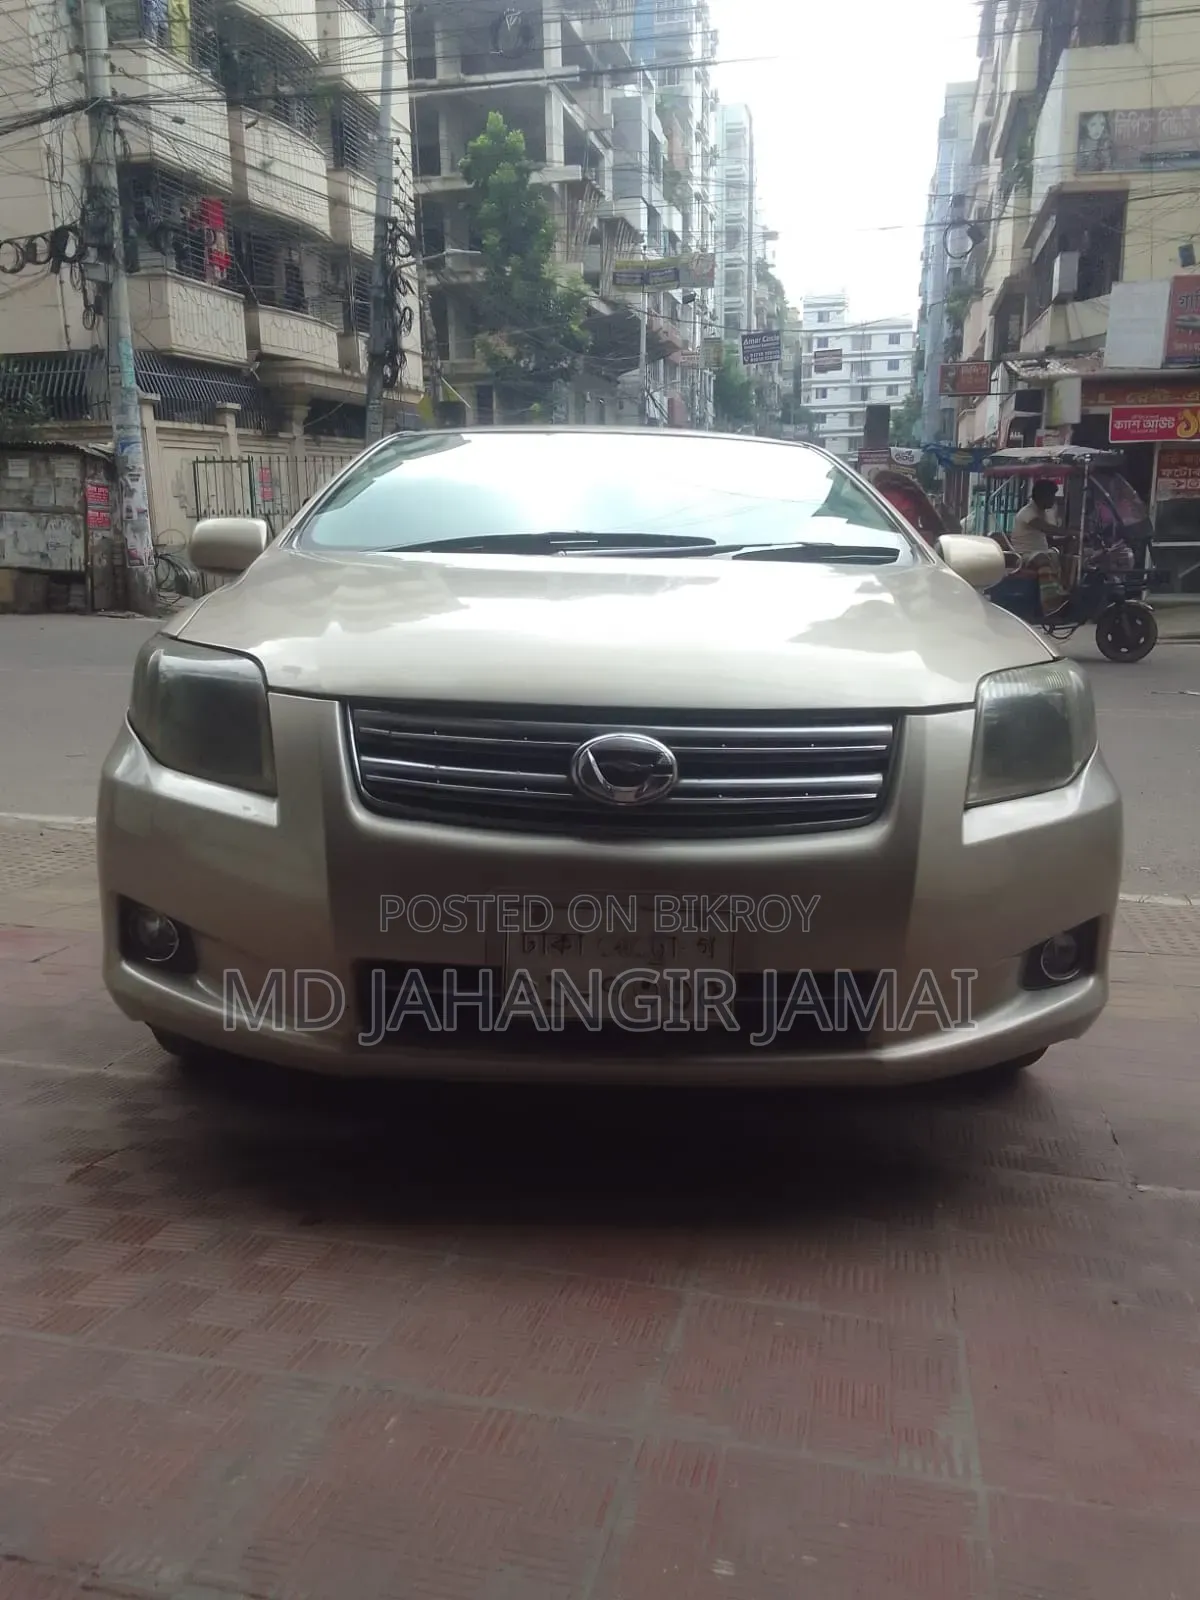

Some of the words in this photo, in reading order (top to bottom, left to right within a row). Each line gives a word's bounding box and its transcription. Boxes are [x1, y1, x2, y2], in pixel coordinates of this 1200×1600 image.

[1114, 419, 1141, 430] ক্যাশ
[1143, 416, 1175, 429] আউট
[521, 932, 586, 957] ঢাকা
